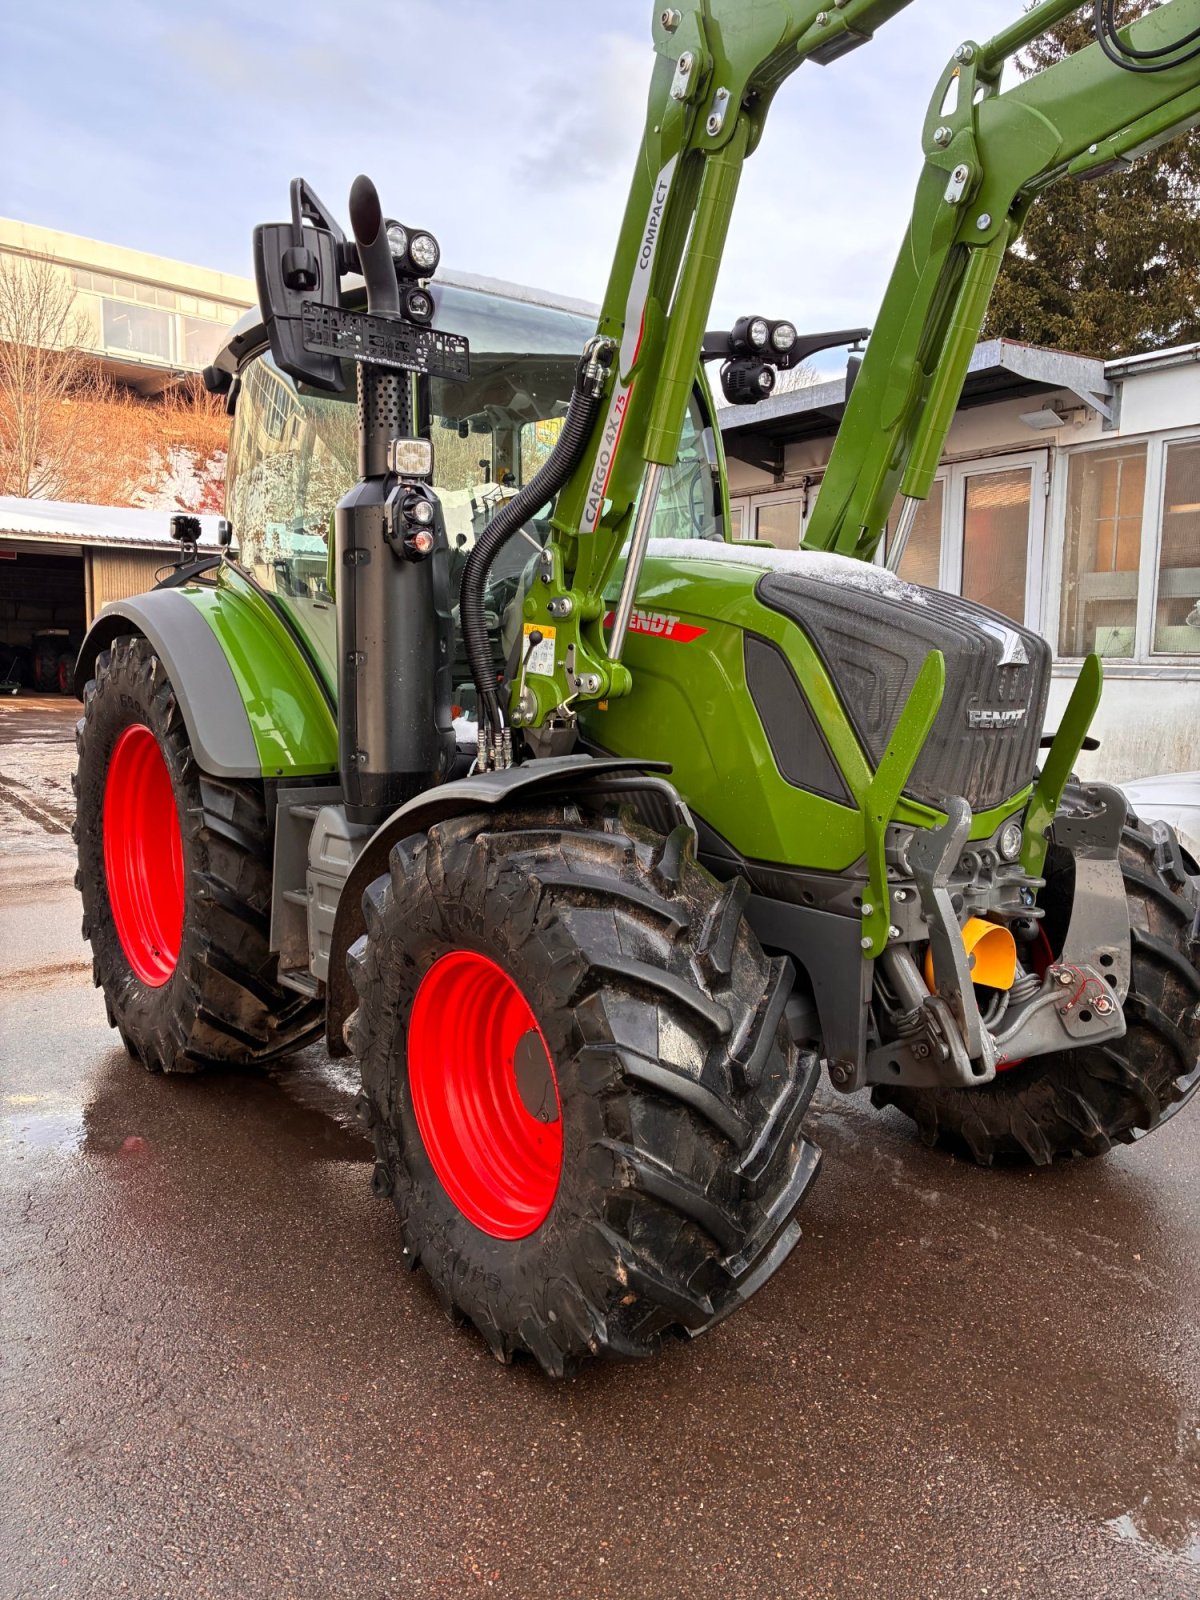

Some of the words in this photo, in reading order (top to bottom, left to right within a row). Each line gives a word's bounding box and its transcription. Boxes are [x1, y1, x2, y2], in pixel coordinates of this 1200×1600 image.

[639, 180, 668, 270] COMPACT
[585, 450, 611, 524] CARGO
[605, 418, 621, 447] 4X
[614, 395, 626, 415] 75
[628, 608, 681, 636] ENDT
[968, 708, 1026, 729] FENDT
